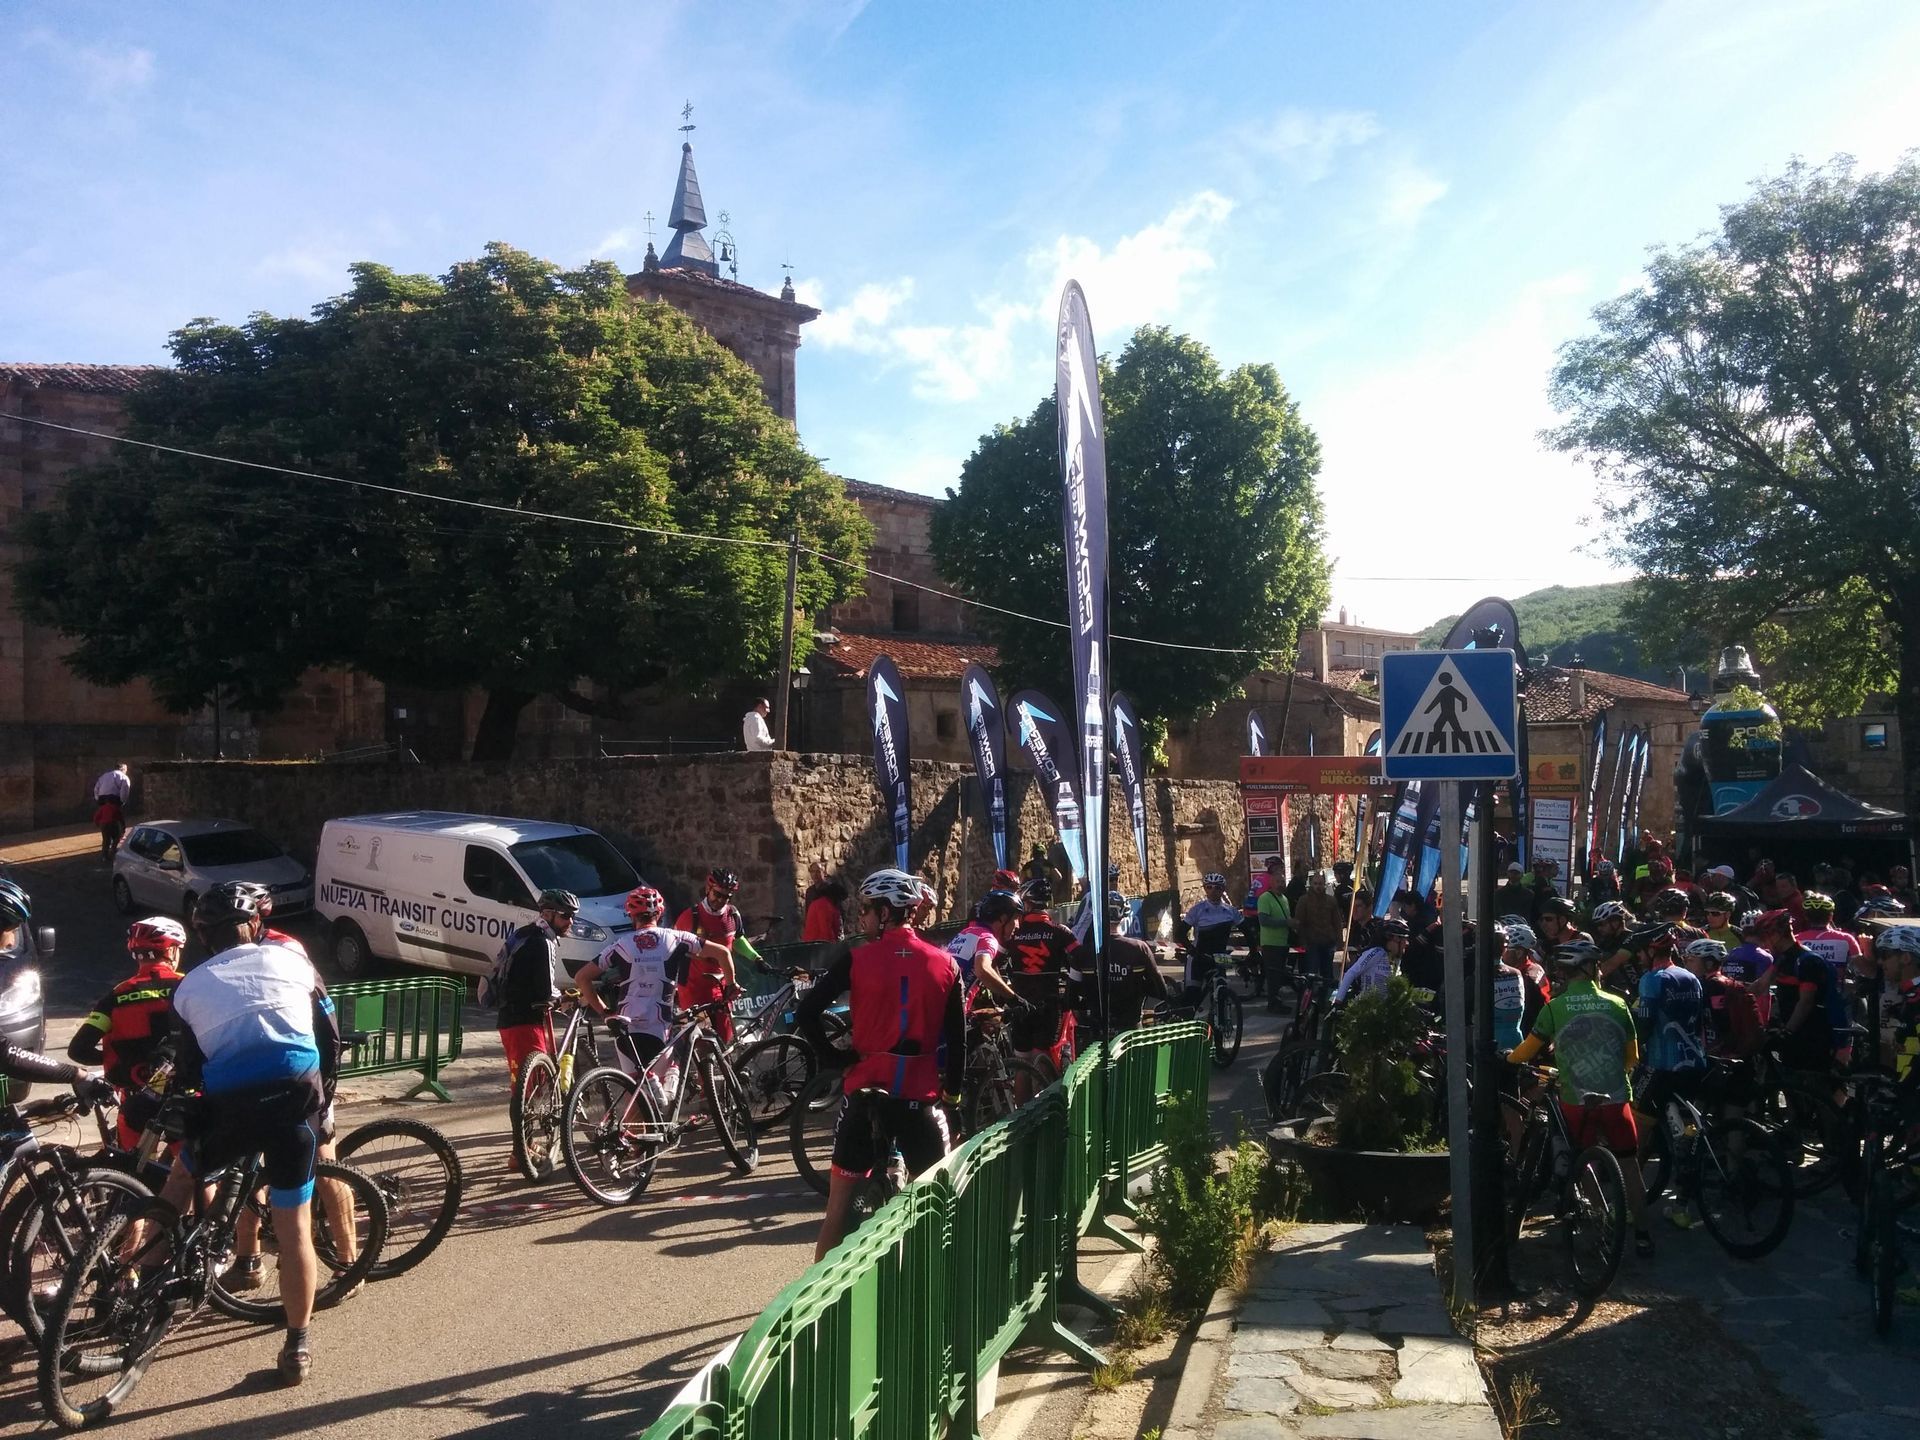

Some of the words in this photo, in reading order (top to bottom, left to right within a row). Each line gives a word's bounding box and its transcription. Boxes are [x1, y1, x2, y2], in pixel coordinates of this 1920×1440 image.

[320, 884, 367, 911] NUEVA
[371, 894, 437, 925] TRANSIT
[441, 909, 516, 940] CUSTOM
[415, 926, 438, 938] Autocid
